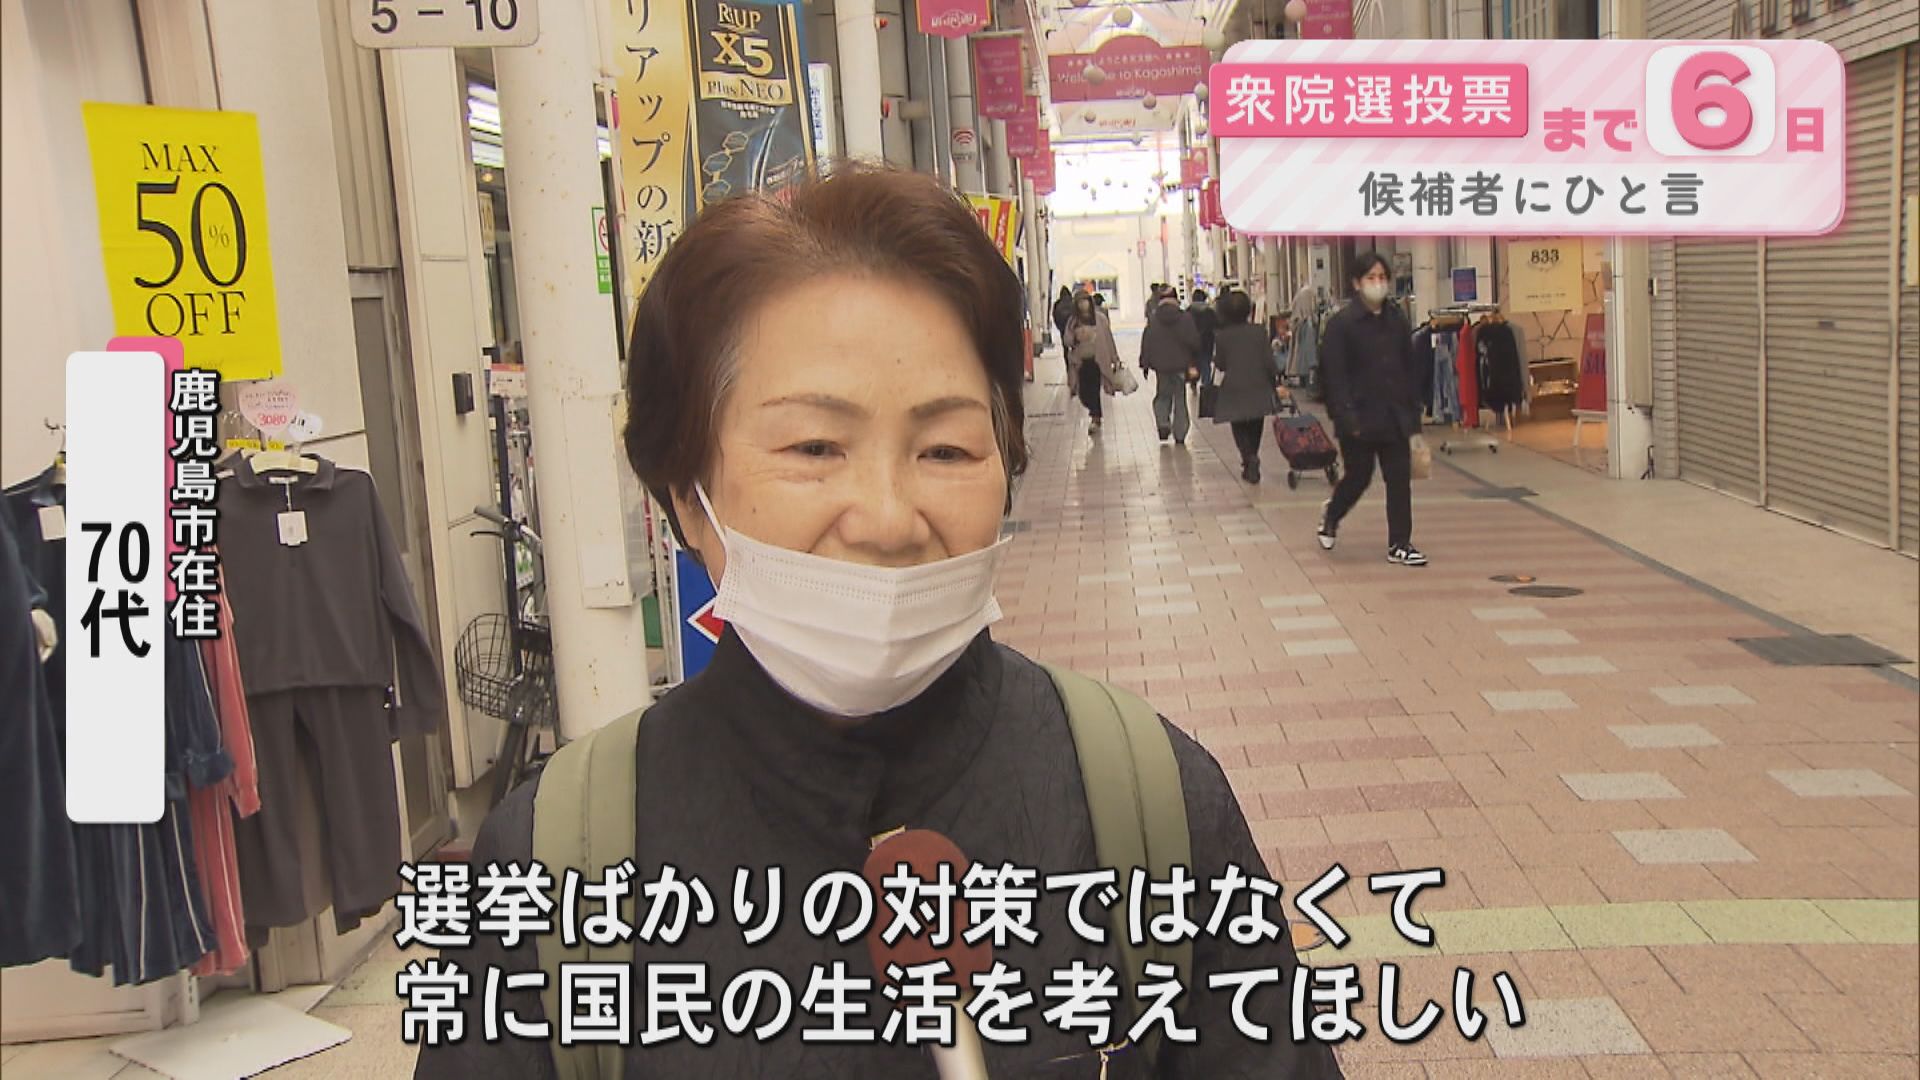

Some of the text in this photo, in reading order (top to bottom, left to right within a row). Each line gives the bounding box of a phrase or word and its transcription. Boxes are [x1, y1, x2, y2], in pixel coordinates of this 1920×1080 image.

[711, 31, 773, 76] X5
[1135, 64, 1203, 81] Kagoshima
[707, 79, 784, 101] Plus NEO
[139, 142, 222, 174] MAX
[626, 0, 676, 284] リアップの新
[1530, 248, 1560, 264] 833
[146, 291, 246, 338] OFF
